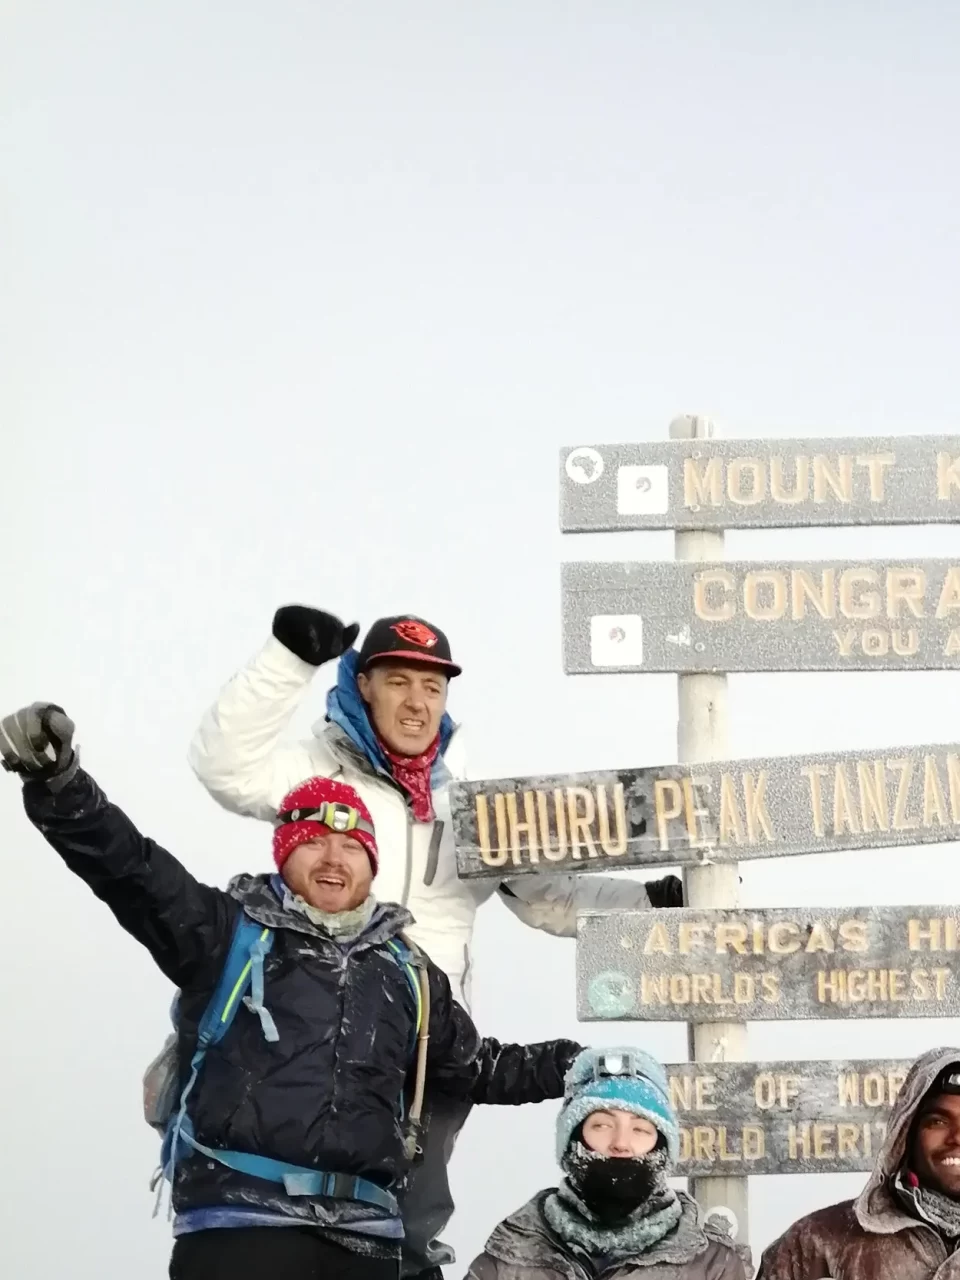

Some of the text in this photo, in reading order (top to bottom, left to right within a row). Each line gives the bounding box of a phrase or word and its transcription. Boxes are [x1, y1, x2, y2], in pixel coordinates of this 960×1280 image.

[683, 454, 895, 506] MOUNT
[834, 628, 920, 657] YOU
[474, 782, 629, 867] UHURU
[653, 769, 776, 852] PEAK
[817, 966, 950, 1003] HIGHEST
[669, 1075, 718, 1111] NE
[754, 1071, 800, 1110] OF
